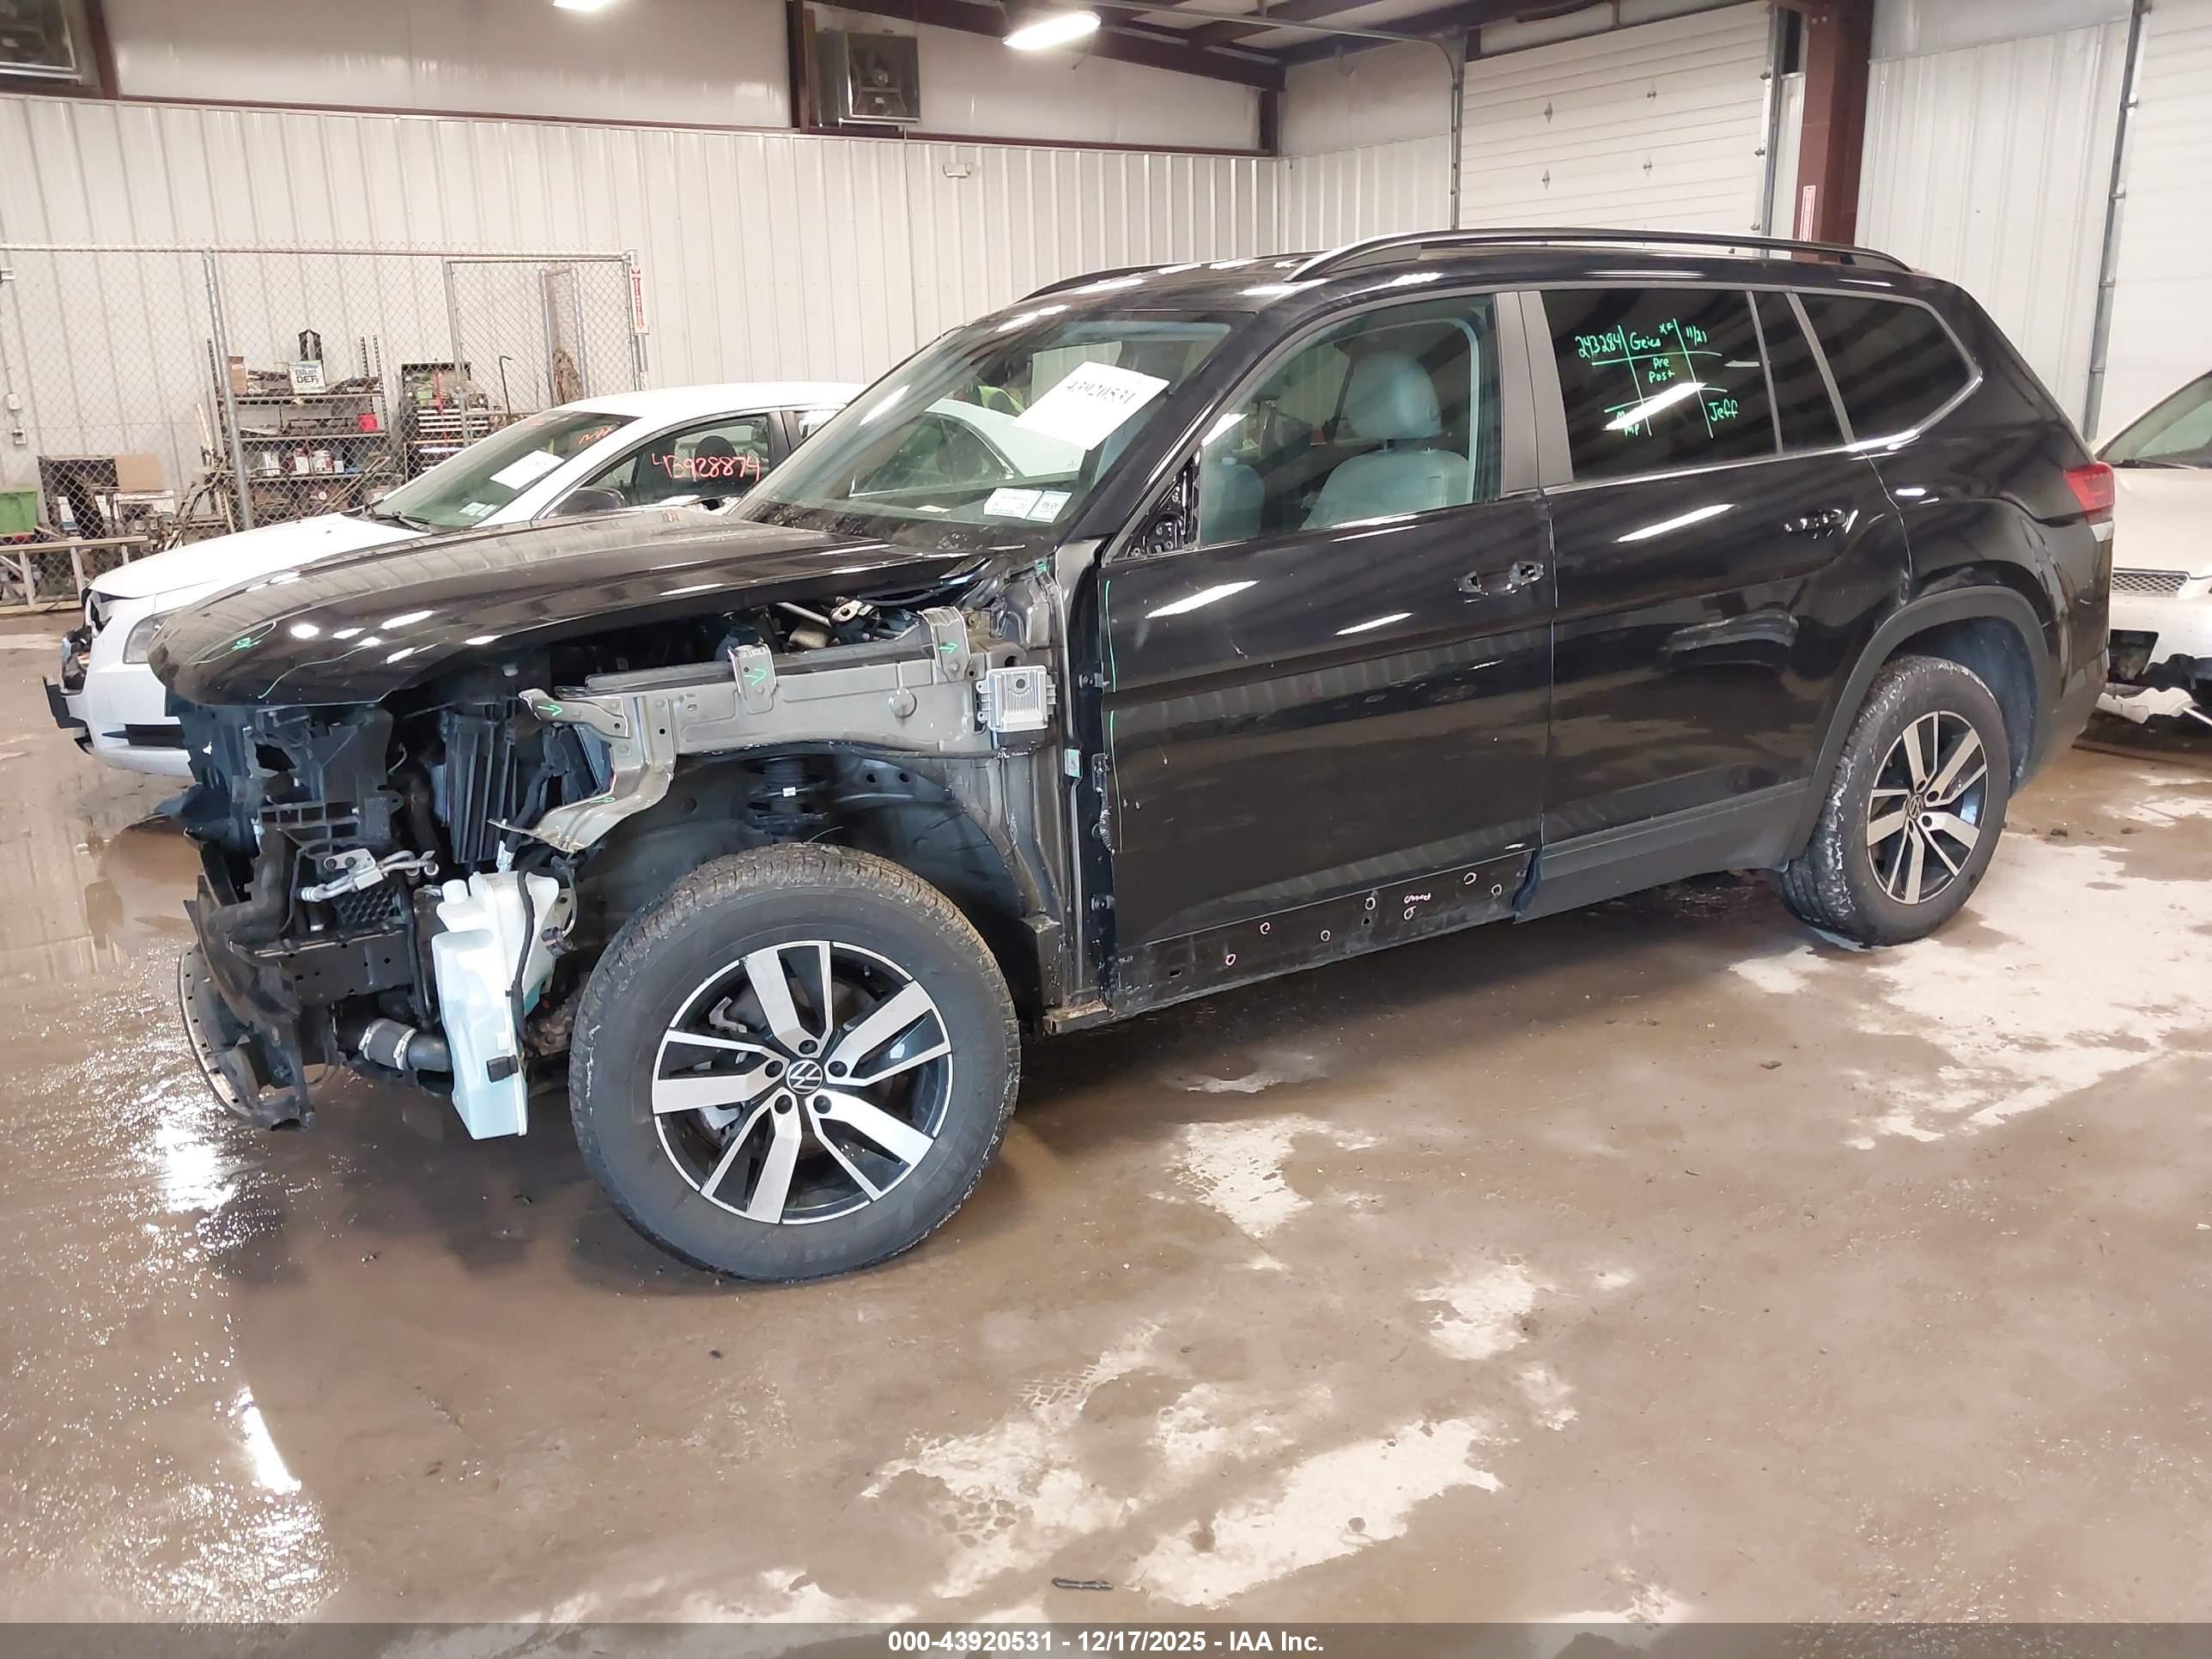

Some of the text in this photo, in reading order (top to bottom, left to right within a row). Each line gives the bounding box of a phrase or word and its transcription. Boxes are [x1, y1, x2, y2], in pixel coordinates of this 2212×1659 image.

[1575, 332, 1623, 360] 243284
[1686, 325, 1707, 346] 11/21
[1708, 398, 1738, 422] Jeff
[652, 453, 760, 482] 43928874
